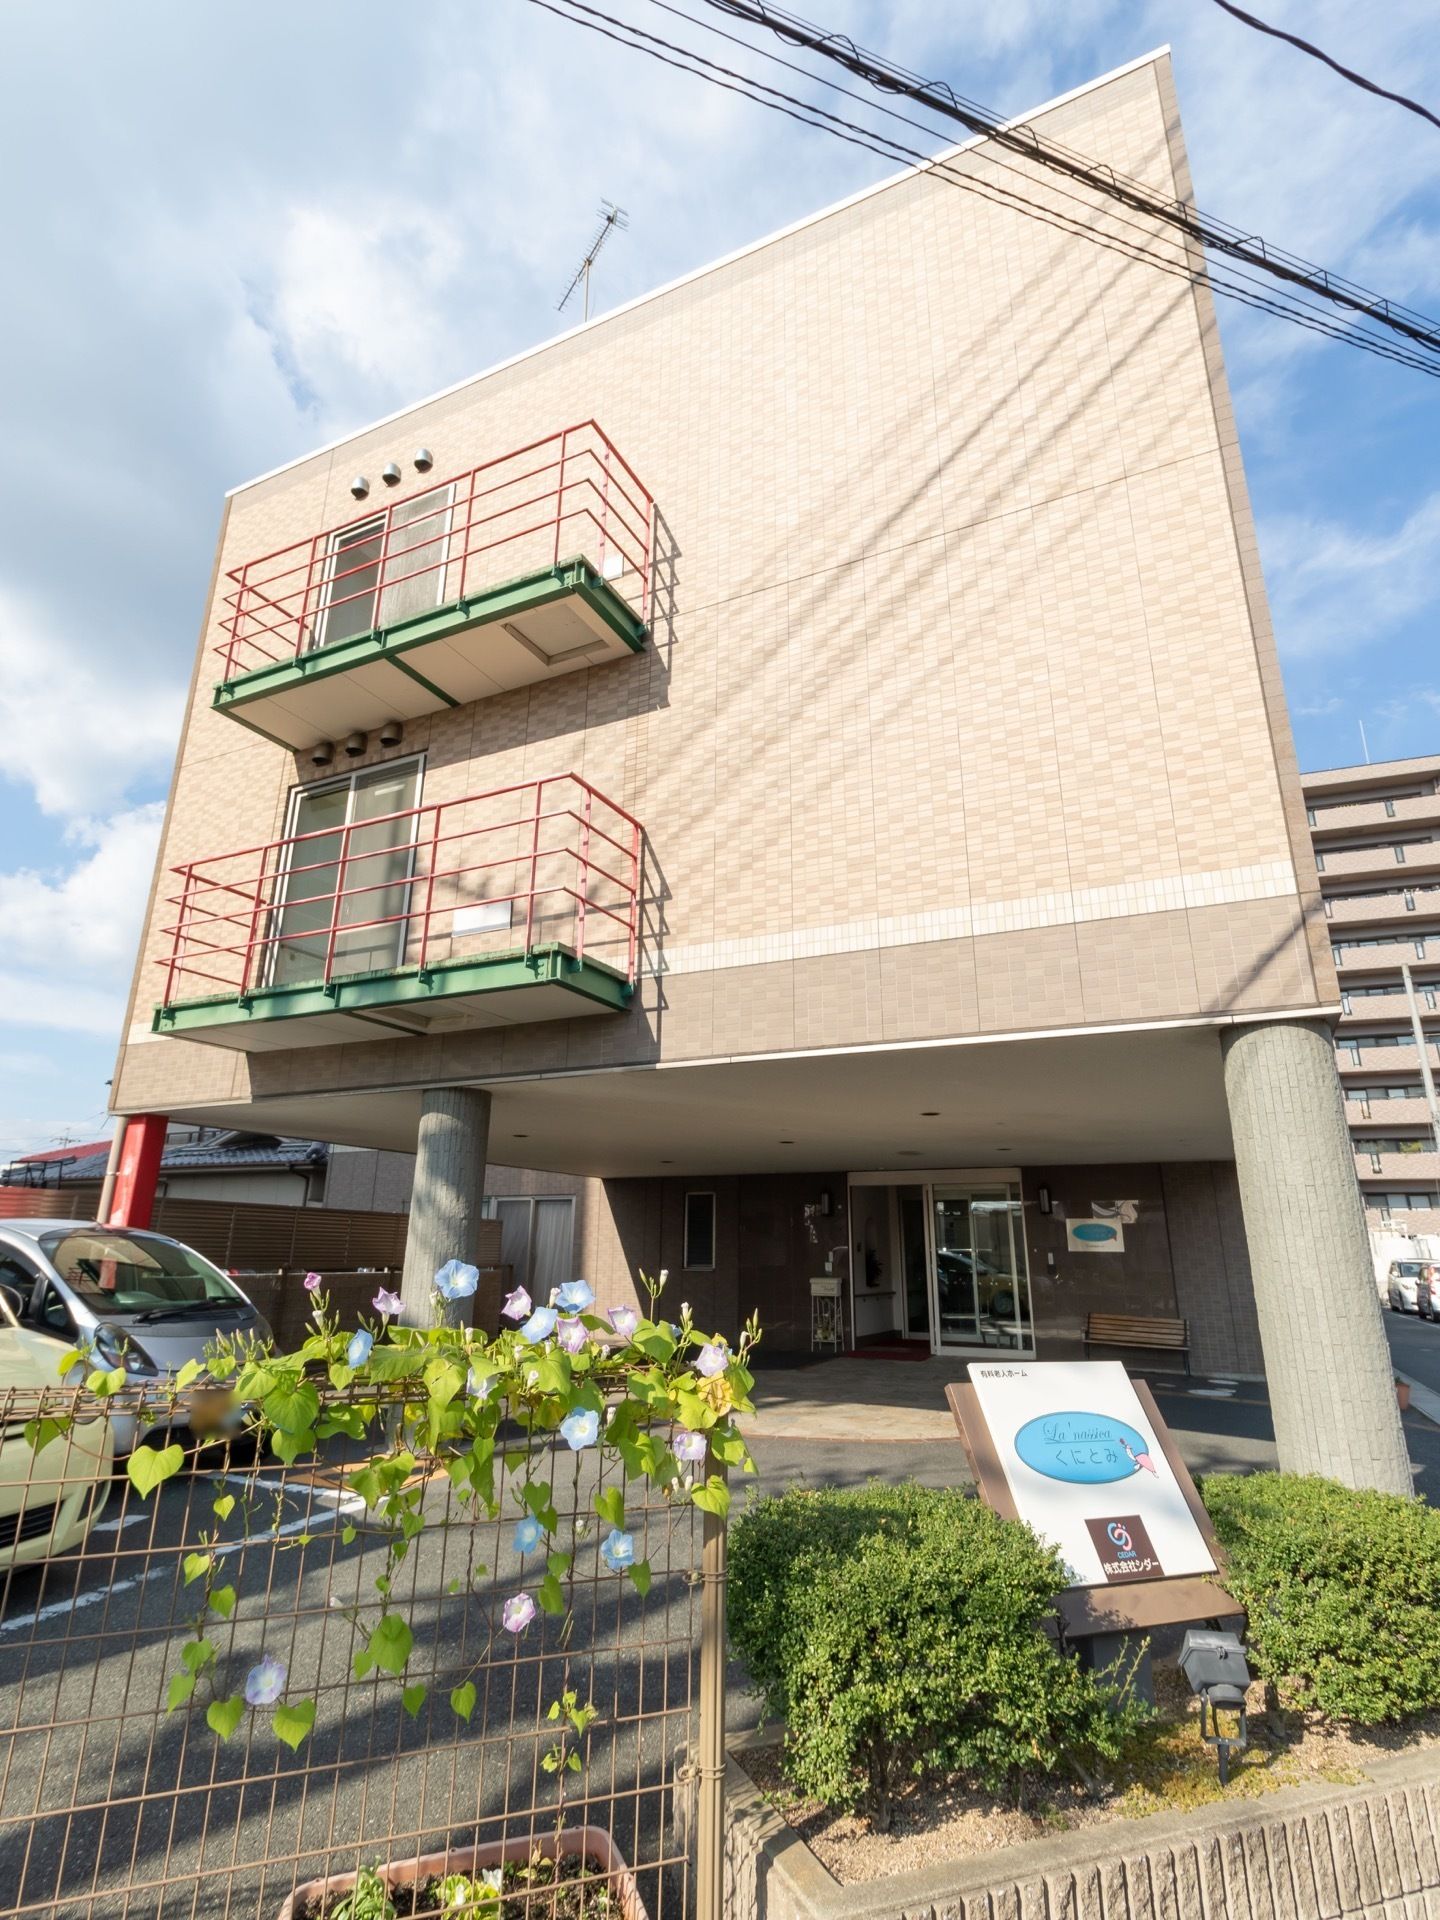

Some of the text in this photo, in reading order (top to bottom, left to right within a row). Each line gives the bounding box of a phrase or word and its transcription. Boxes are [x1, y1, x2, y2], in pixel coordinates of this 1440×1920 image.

[1055, 1448, 1119, 1466] くにとみ
[1117, 1550, 1137, 1559] CEDAR
[1103, 1558, 1159, 1576] 株式会社シダー
